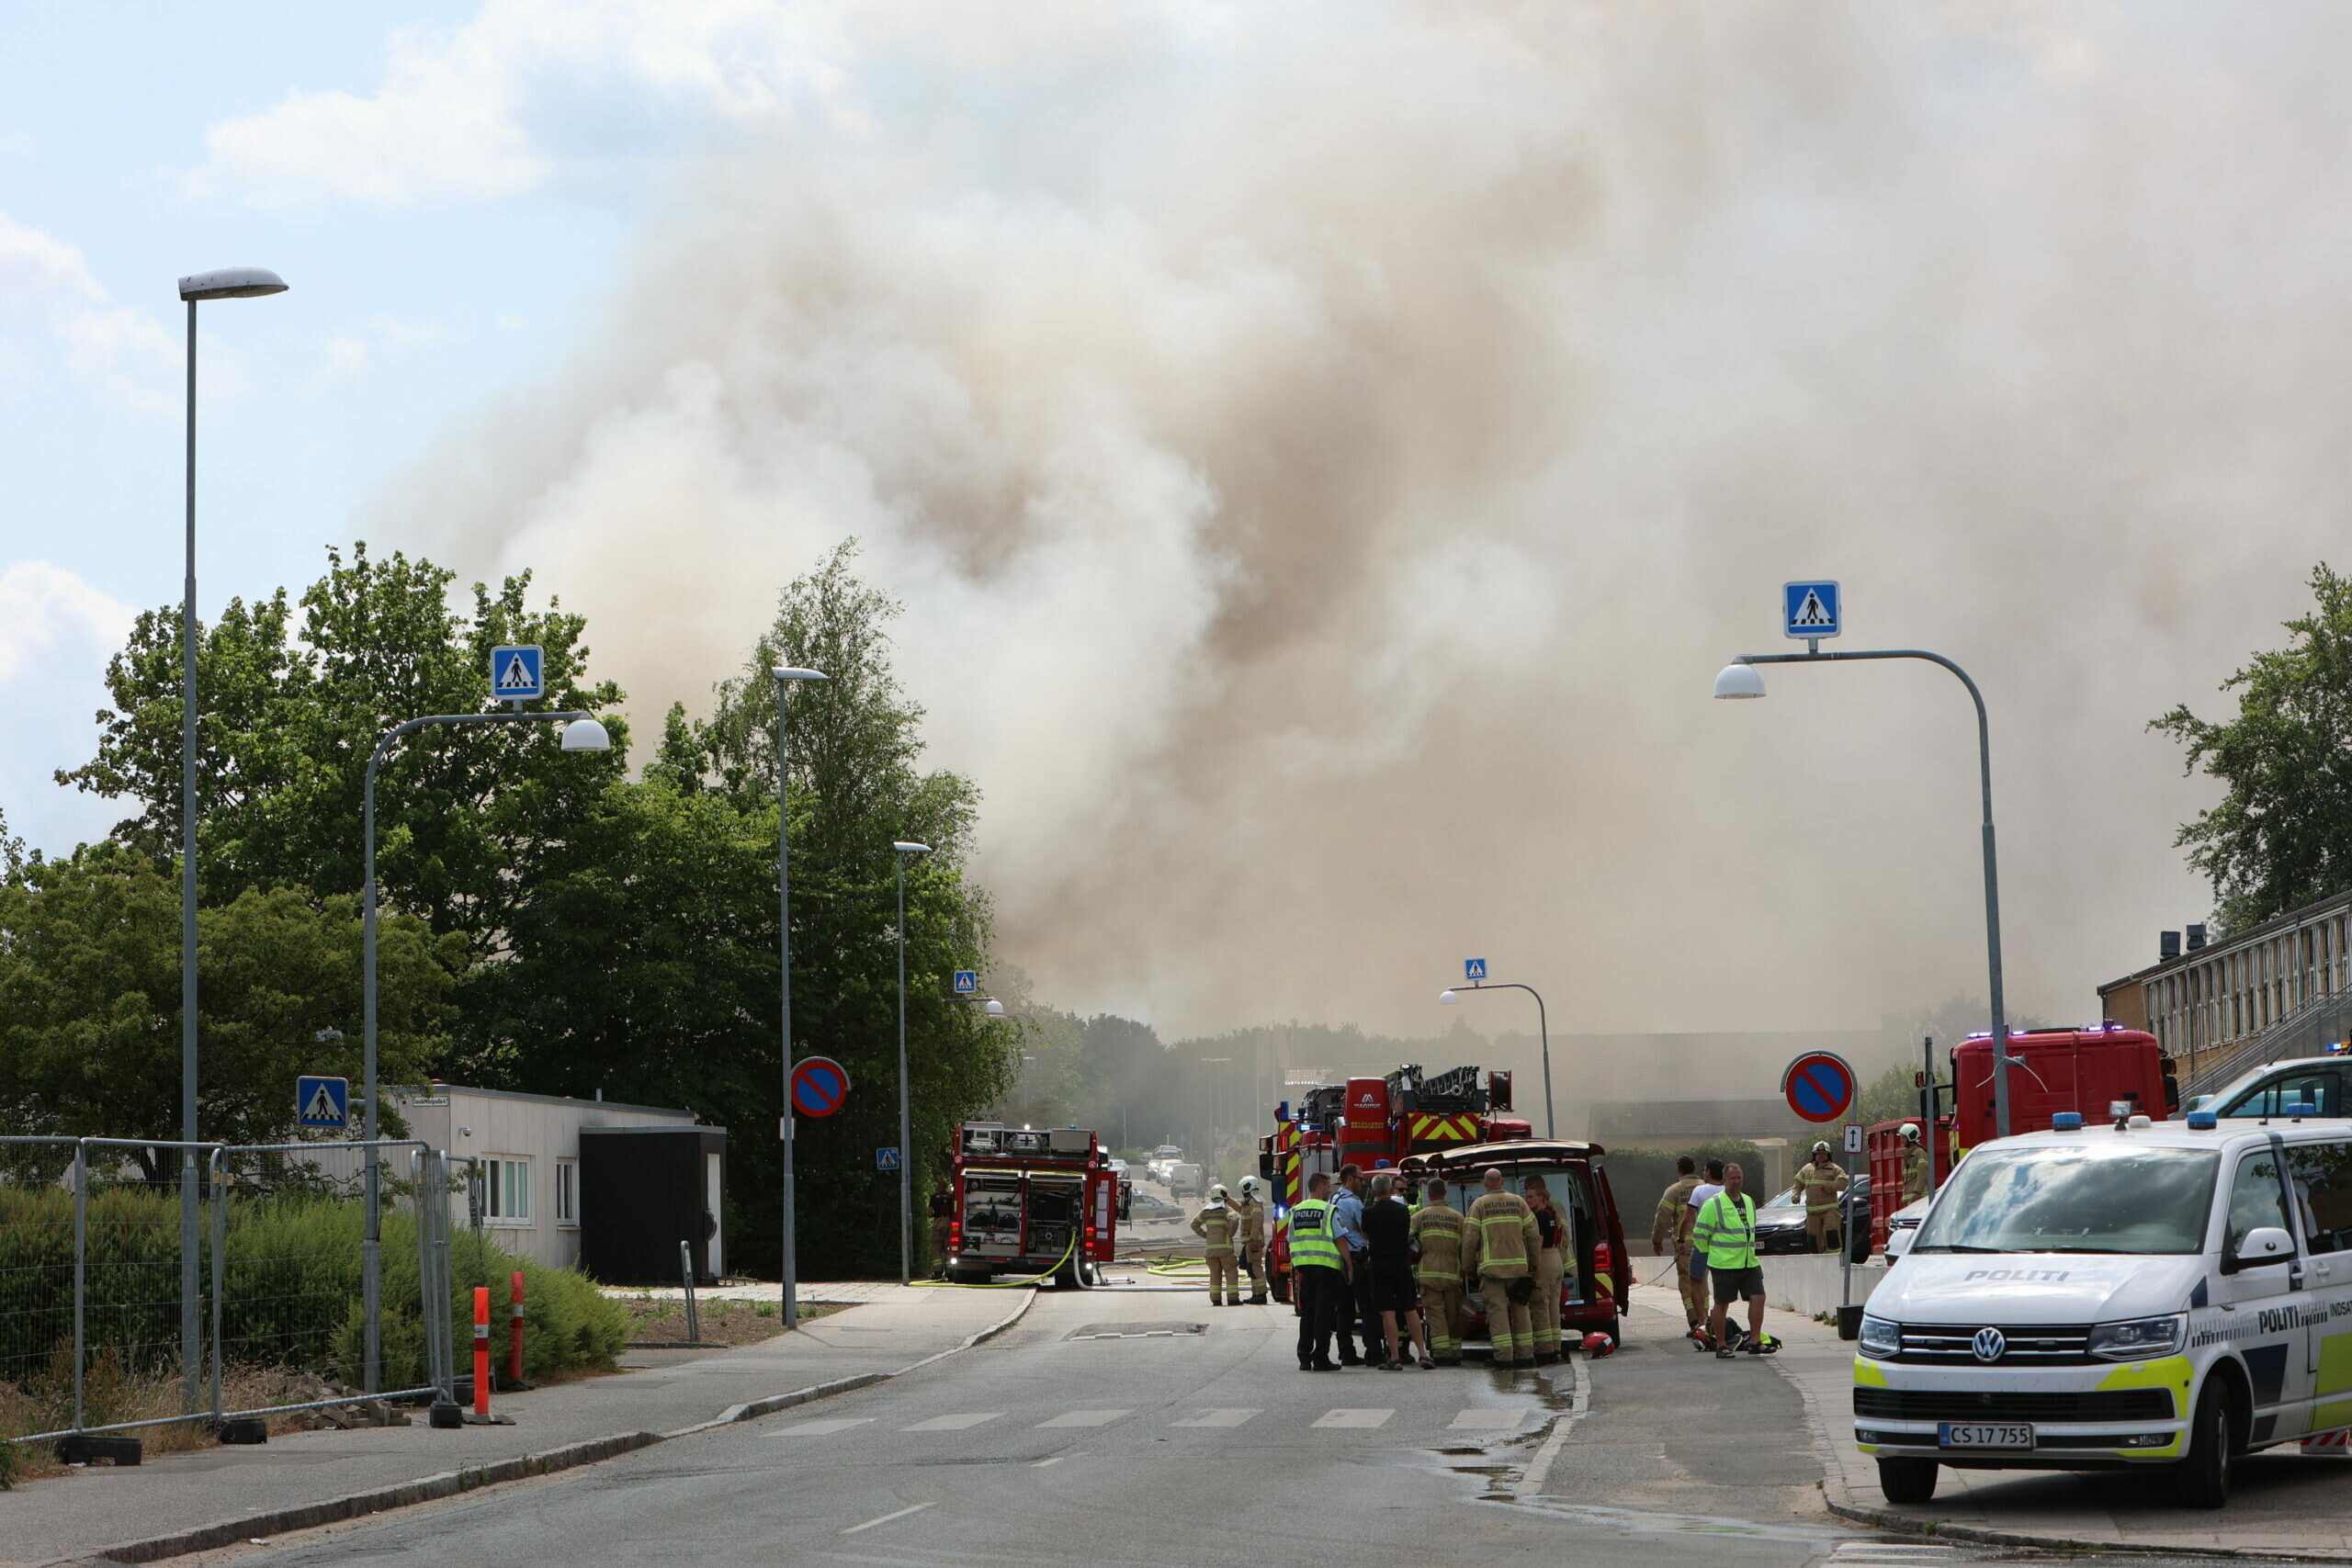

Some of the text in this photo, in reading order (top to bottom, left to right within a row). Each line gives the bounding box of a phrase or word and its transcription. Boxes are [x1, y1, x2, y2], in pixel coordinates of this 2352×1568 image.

[1295, 1210, 1322, 1219] POLITI
[1963, 1269, 2071, 1282] POLITI
[2258, 1305, 2300, 1335] POLITI
[1951, 1427, 2029, 1443] CS 17 755
